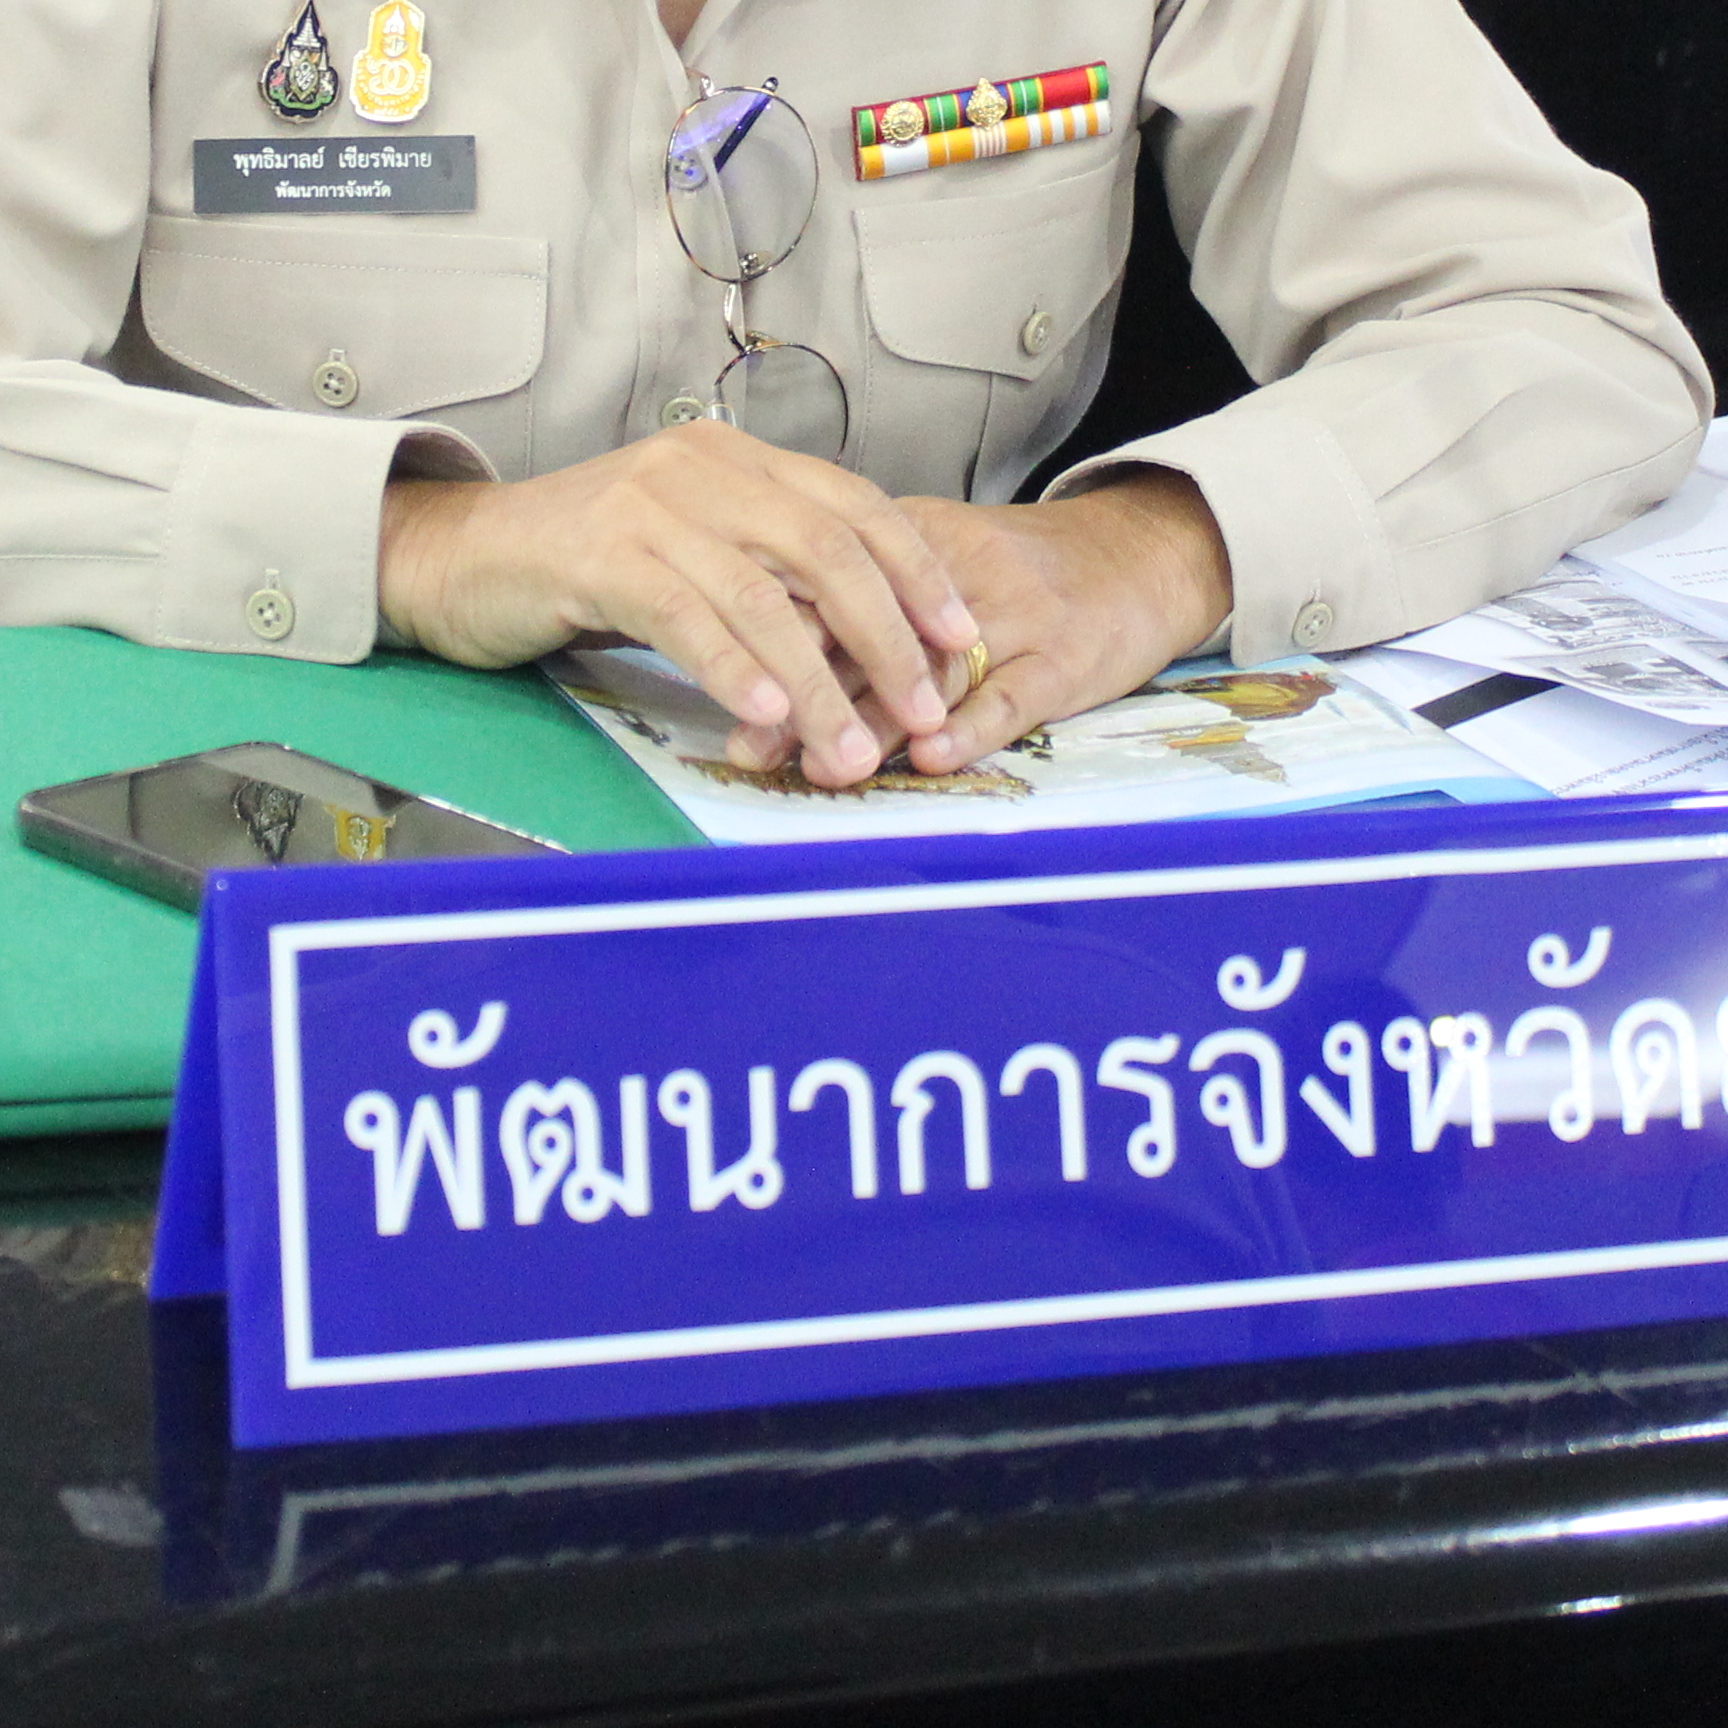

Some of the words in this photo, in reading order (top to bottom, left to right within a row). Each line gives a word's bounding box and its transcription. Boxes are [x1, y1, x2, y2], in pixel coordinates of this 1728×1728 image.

[275, 179, 392, 199] พัฒนาการจังหวัด
